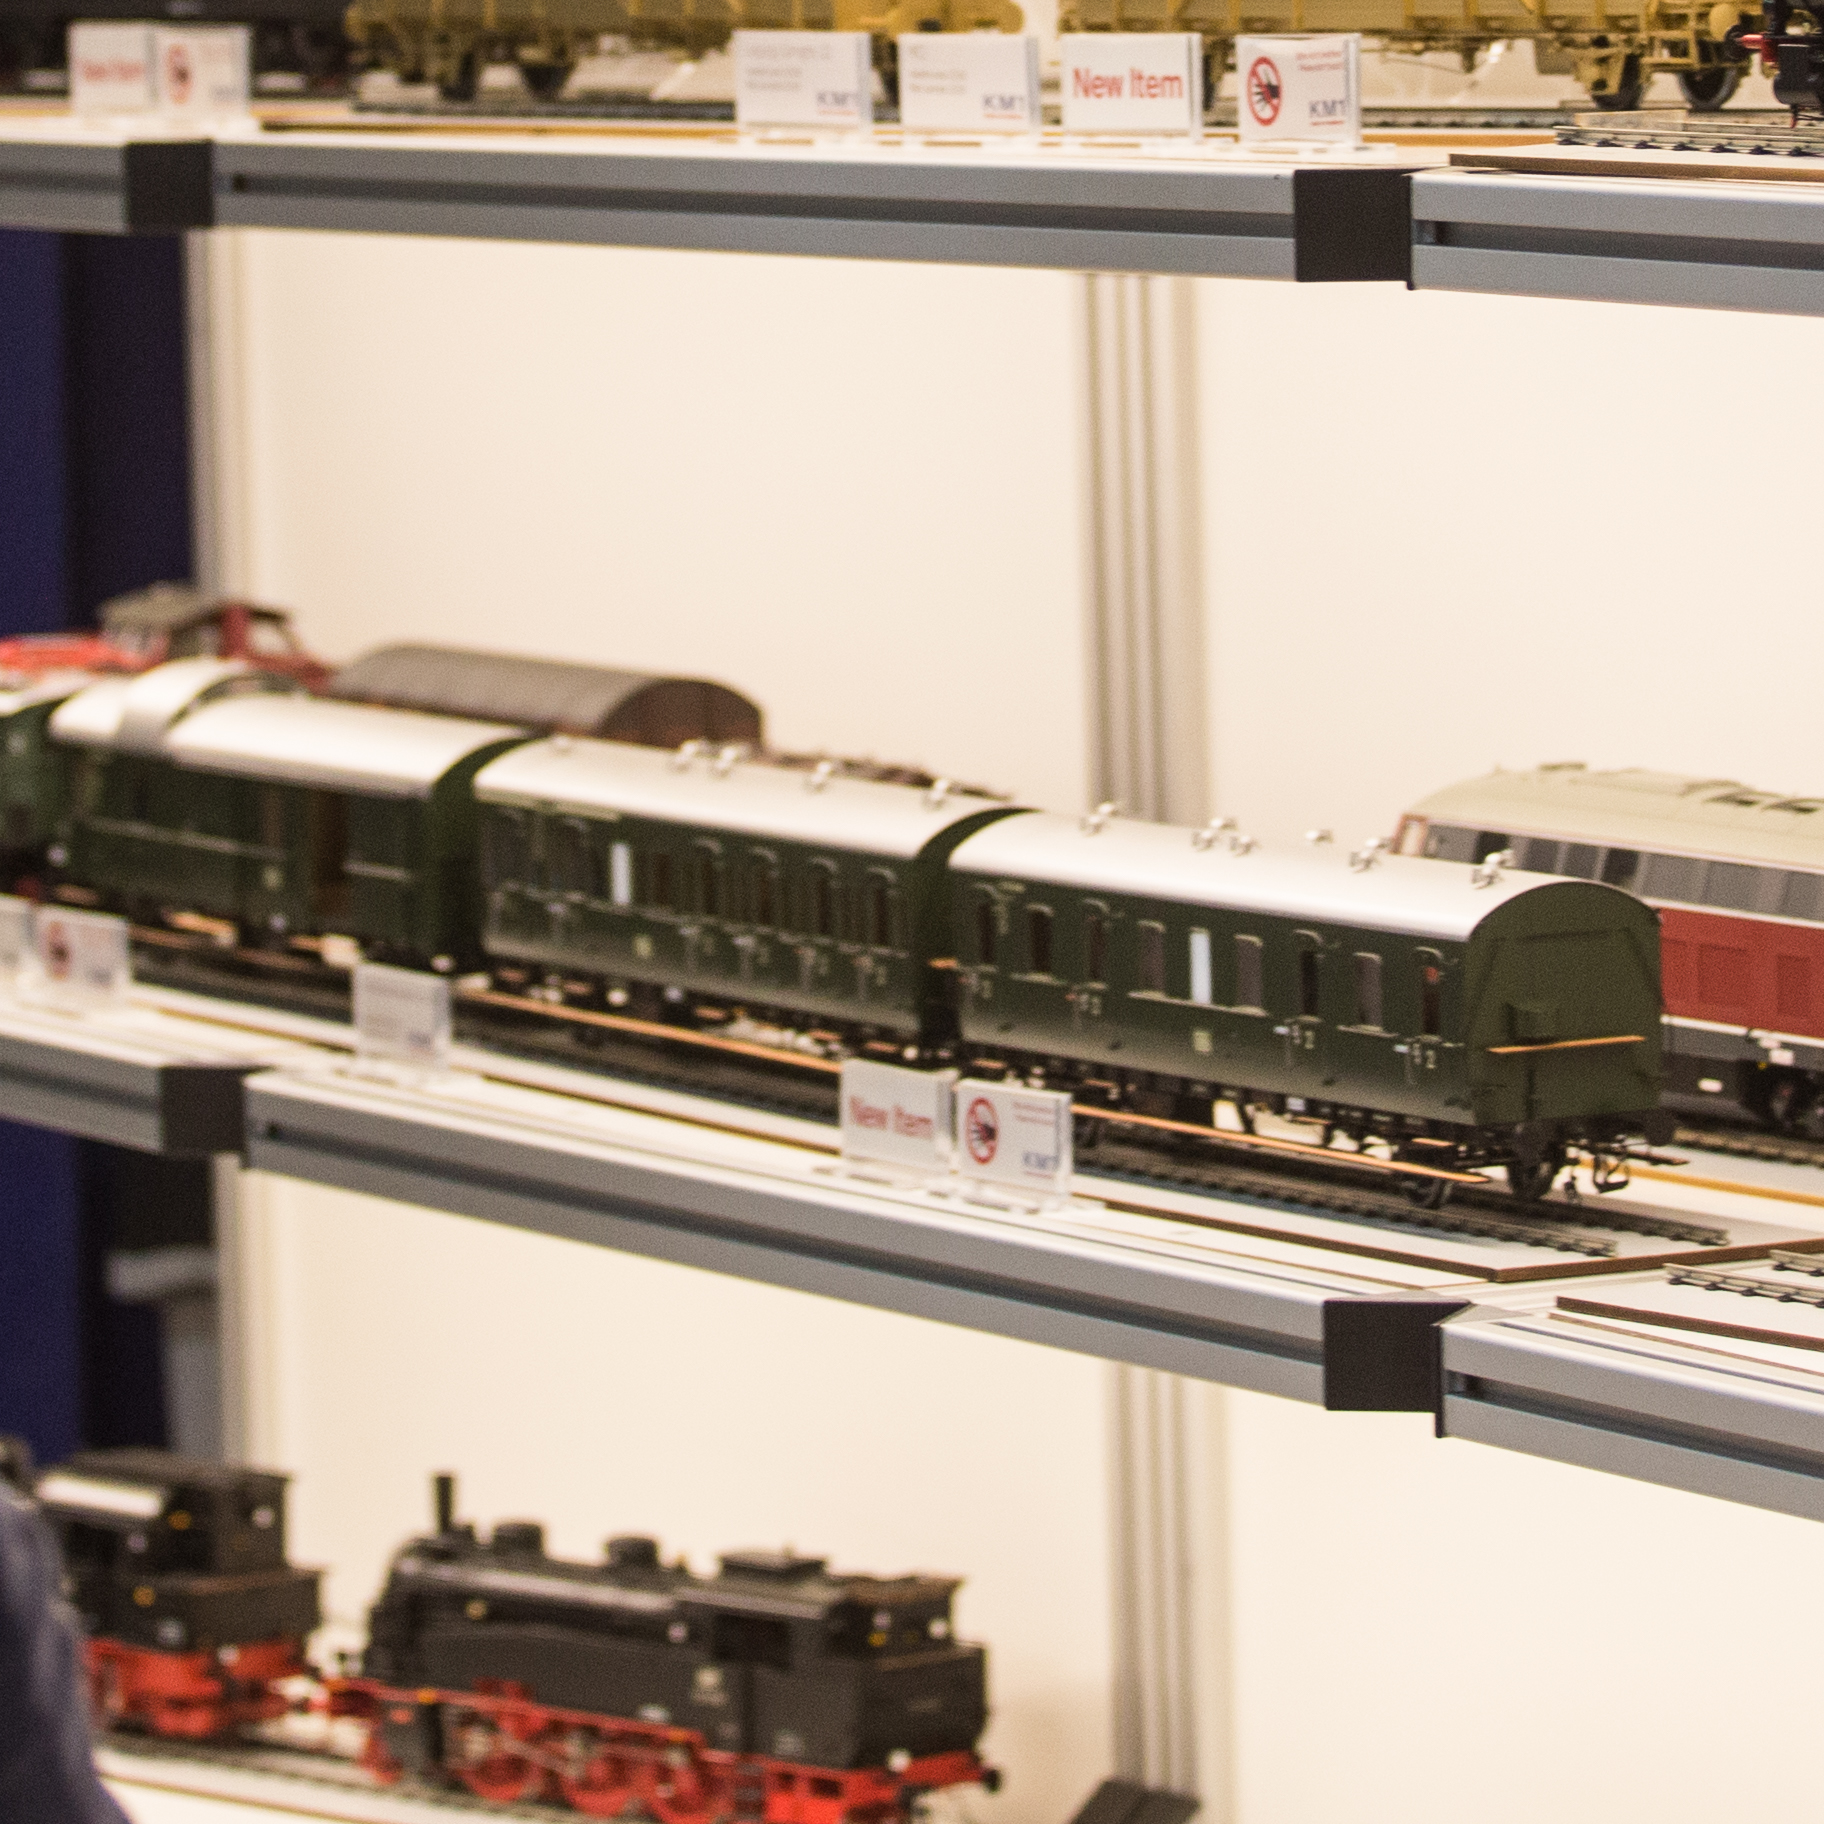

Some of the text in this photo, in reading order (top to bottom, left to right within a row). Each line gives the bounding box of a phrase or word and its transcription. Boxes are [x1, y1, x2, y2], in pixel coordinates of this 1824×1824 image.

[1072, 68, 1183, 99] New Item
[982, 93, 1024, 111] KM1
[1309, 100, 1347, 118] KM1
[850, 1095, 888, 1130] New
